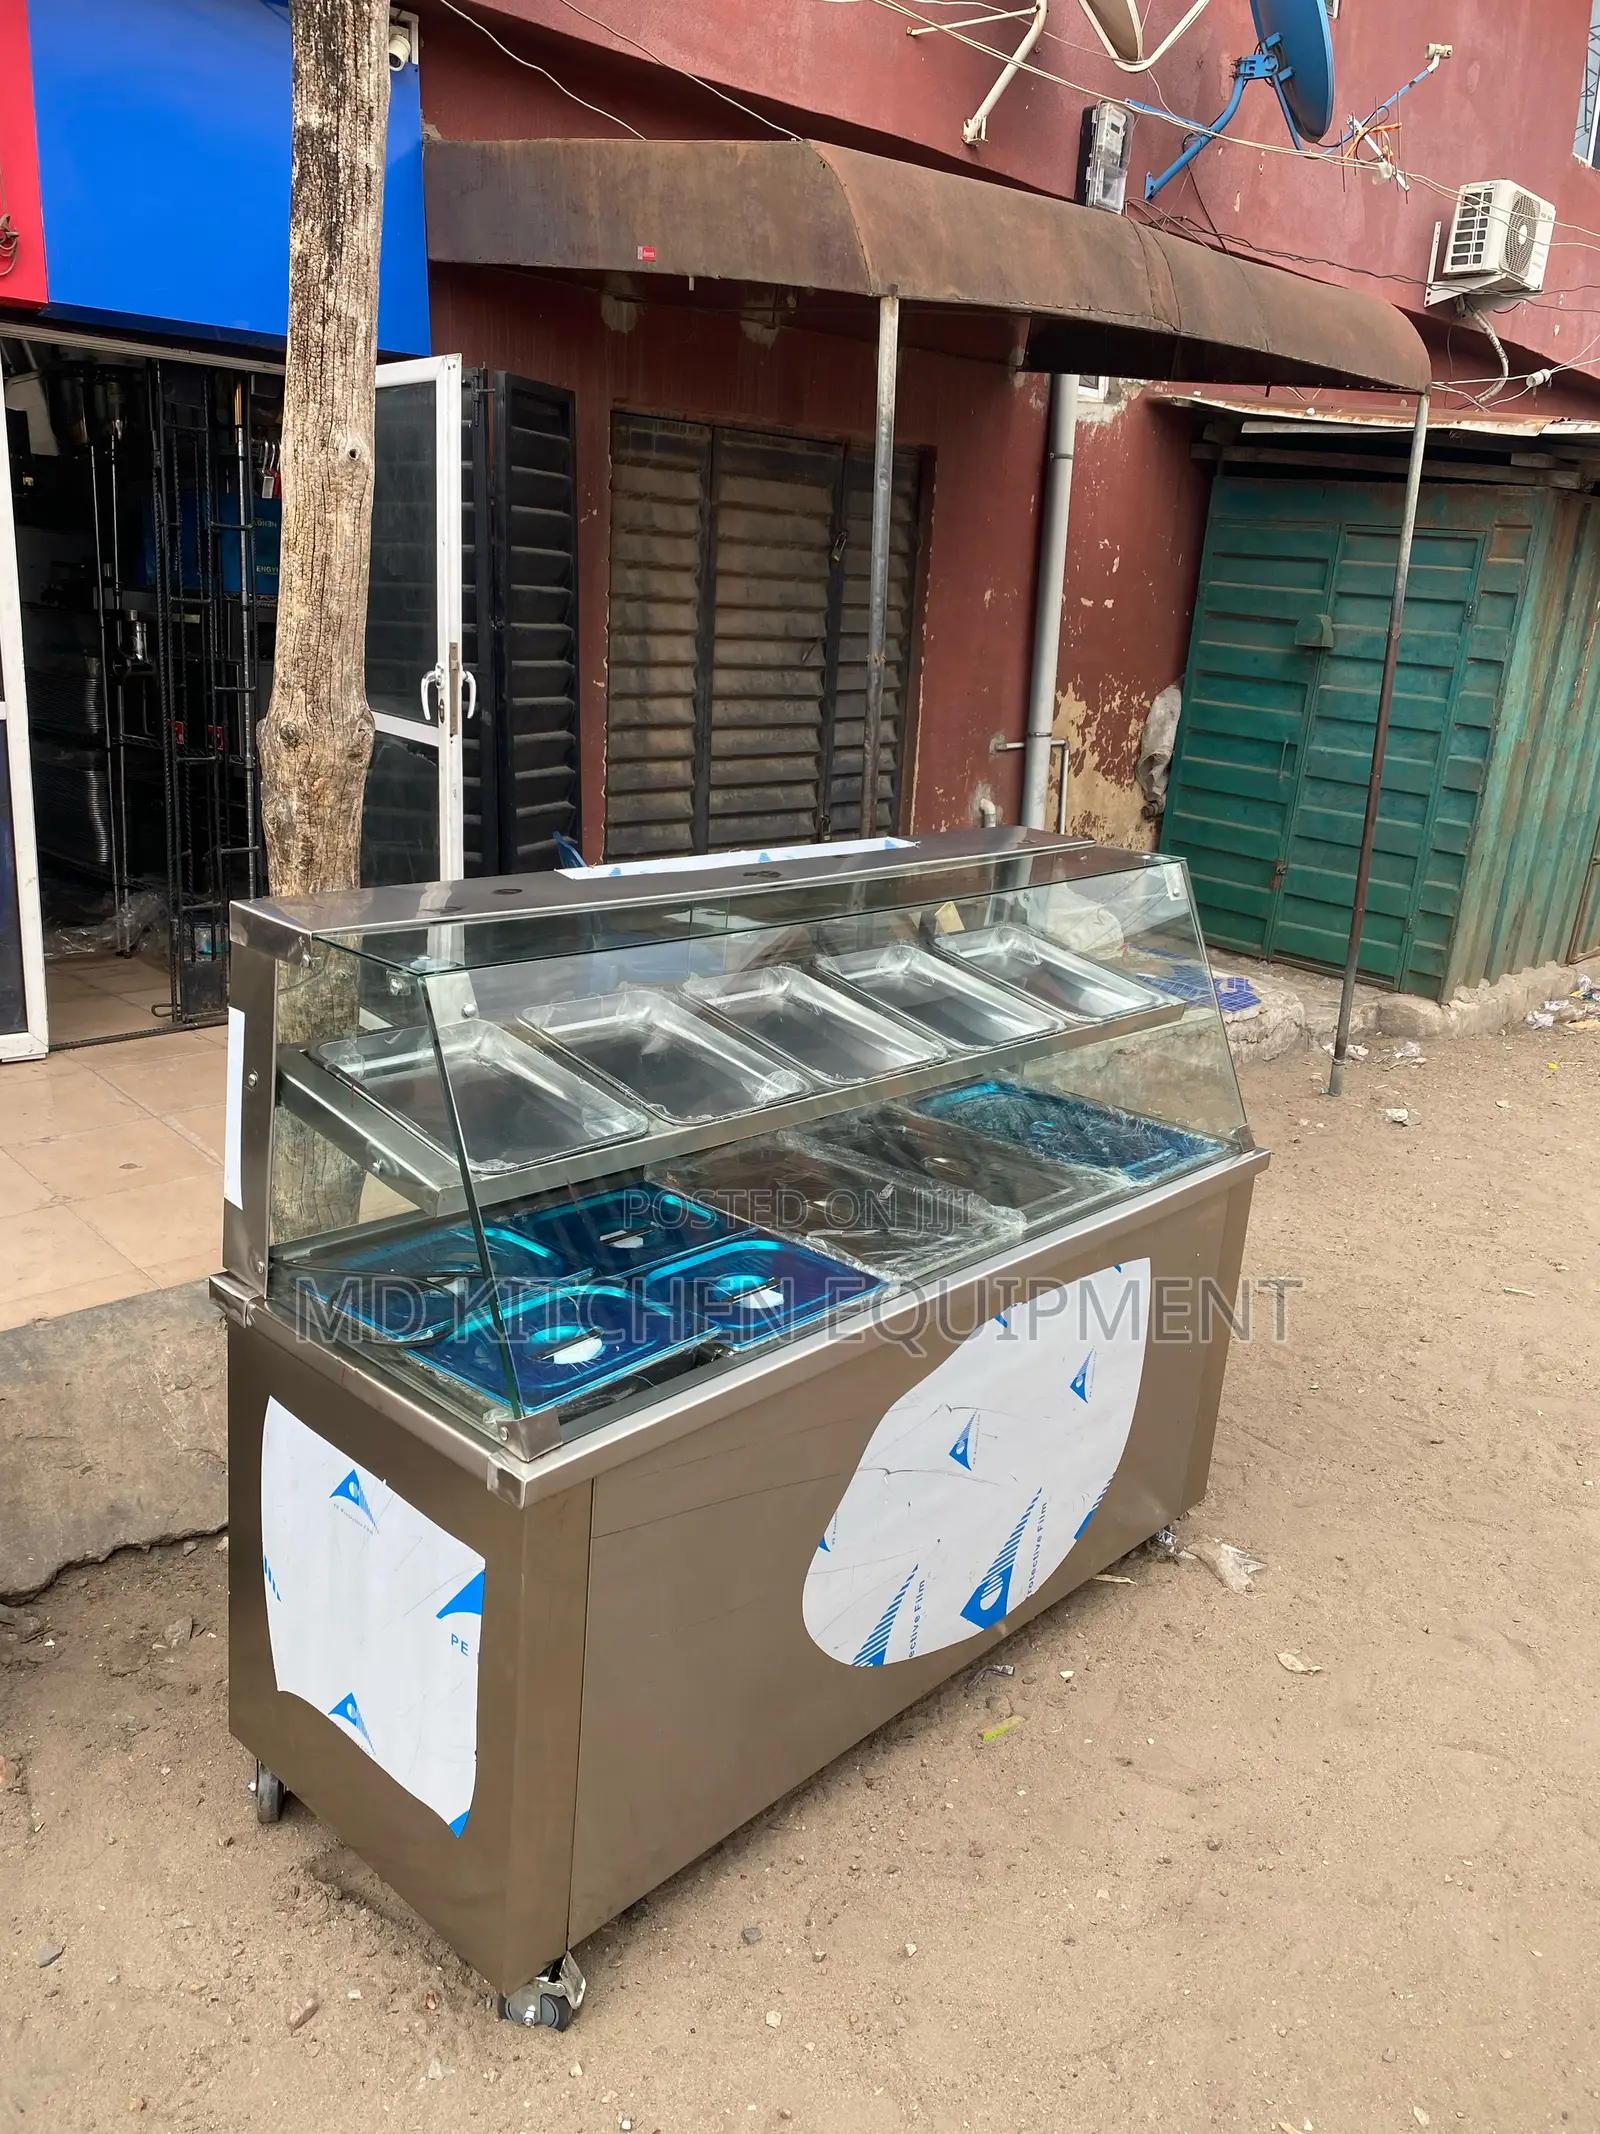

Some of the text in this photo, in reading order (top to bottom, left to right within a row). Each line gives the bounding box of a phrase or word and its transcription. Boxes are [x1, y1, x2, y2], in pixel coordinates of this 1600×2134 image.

[1036, 1502, 1048, 1533] Film
[908, 1579, 926, 1658] ective Film
[451, 1632, 469, 1657] PE
